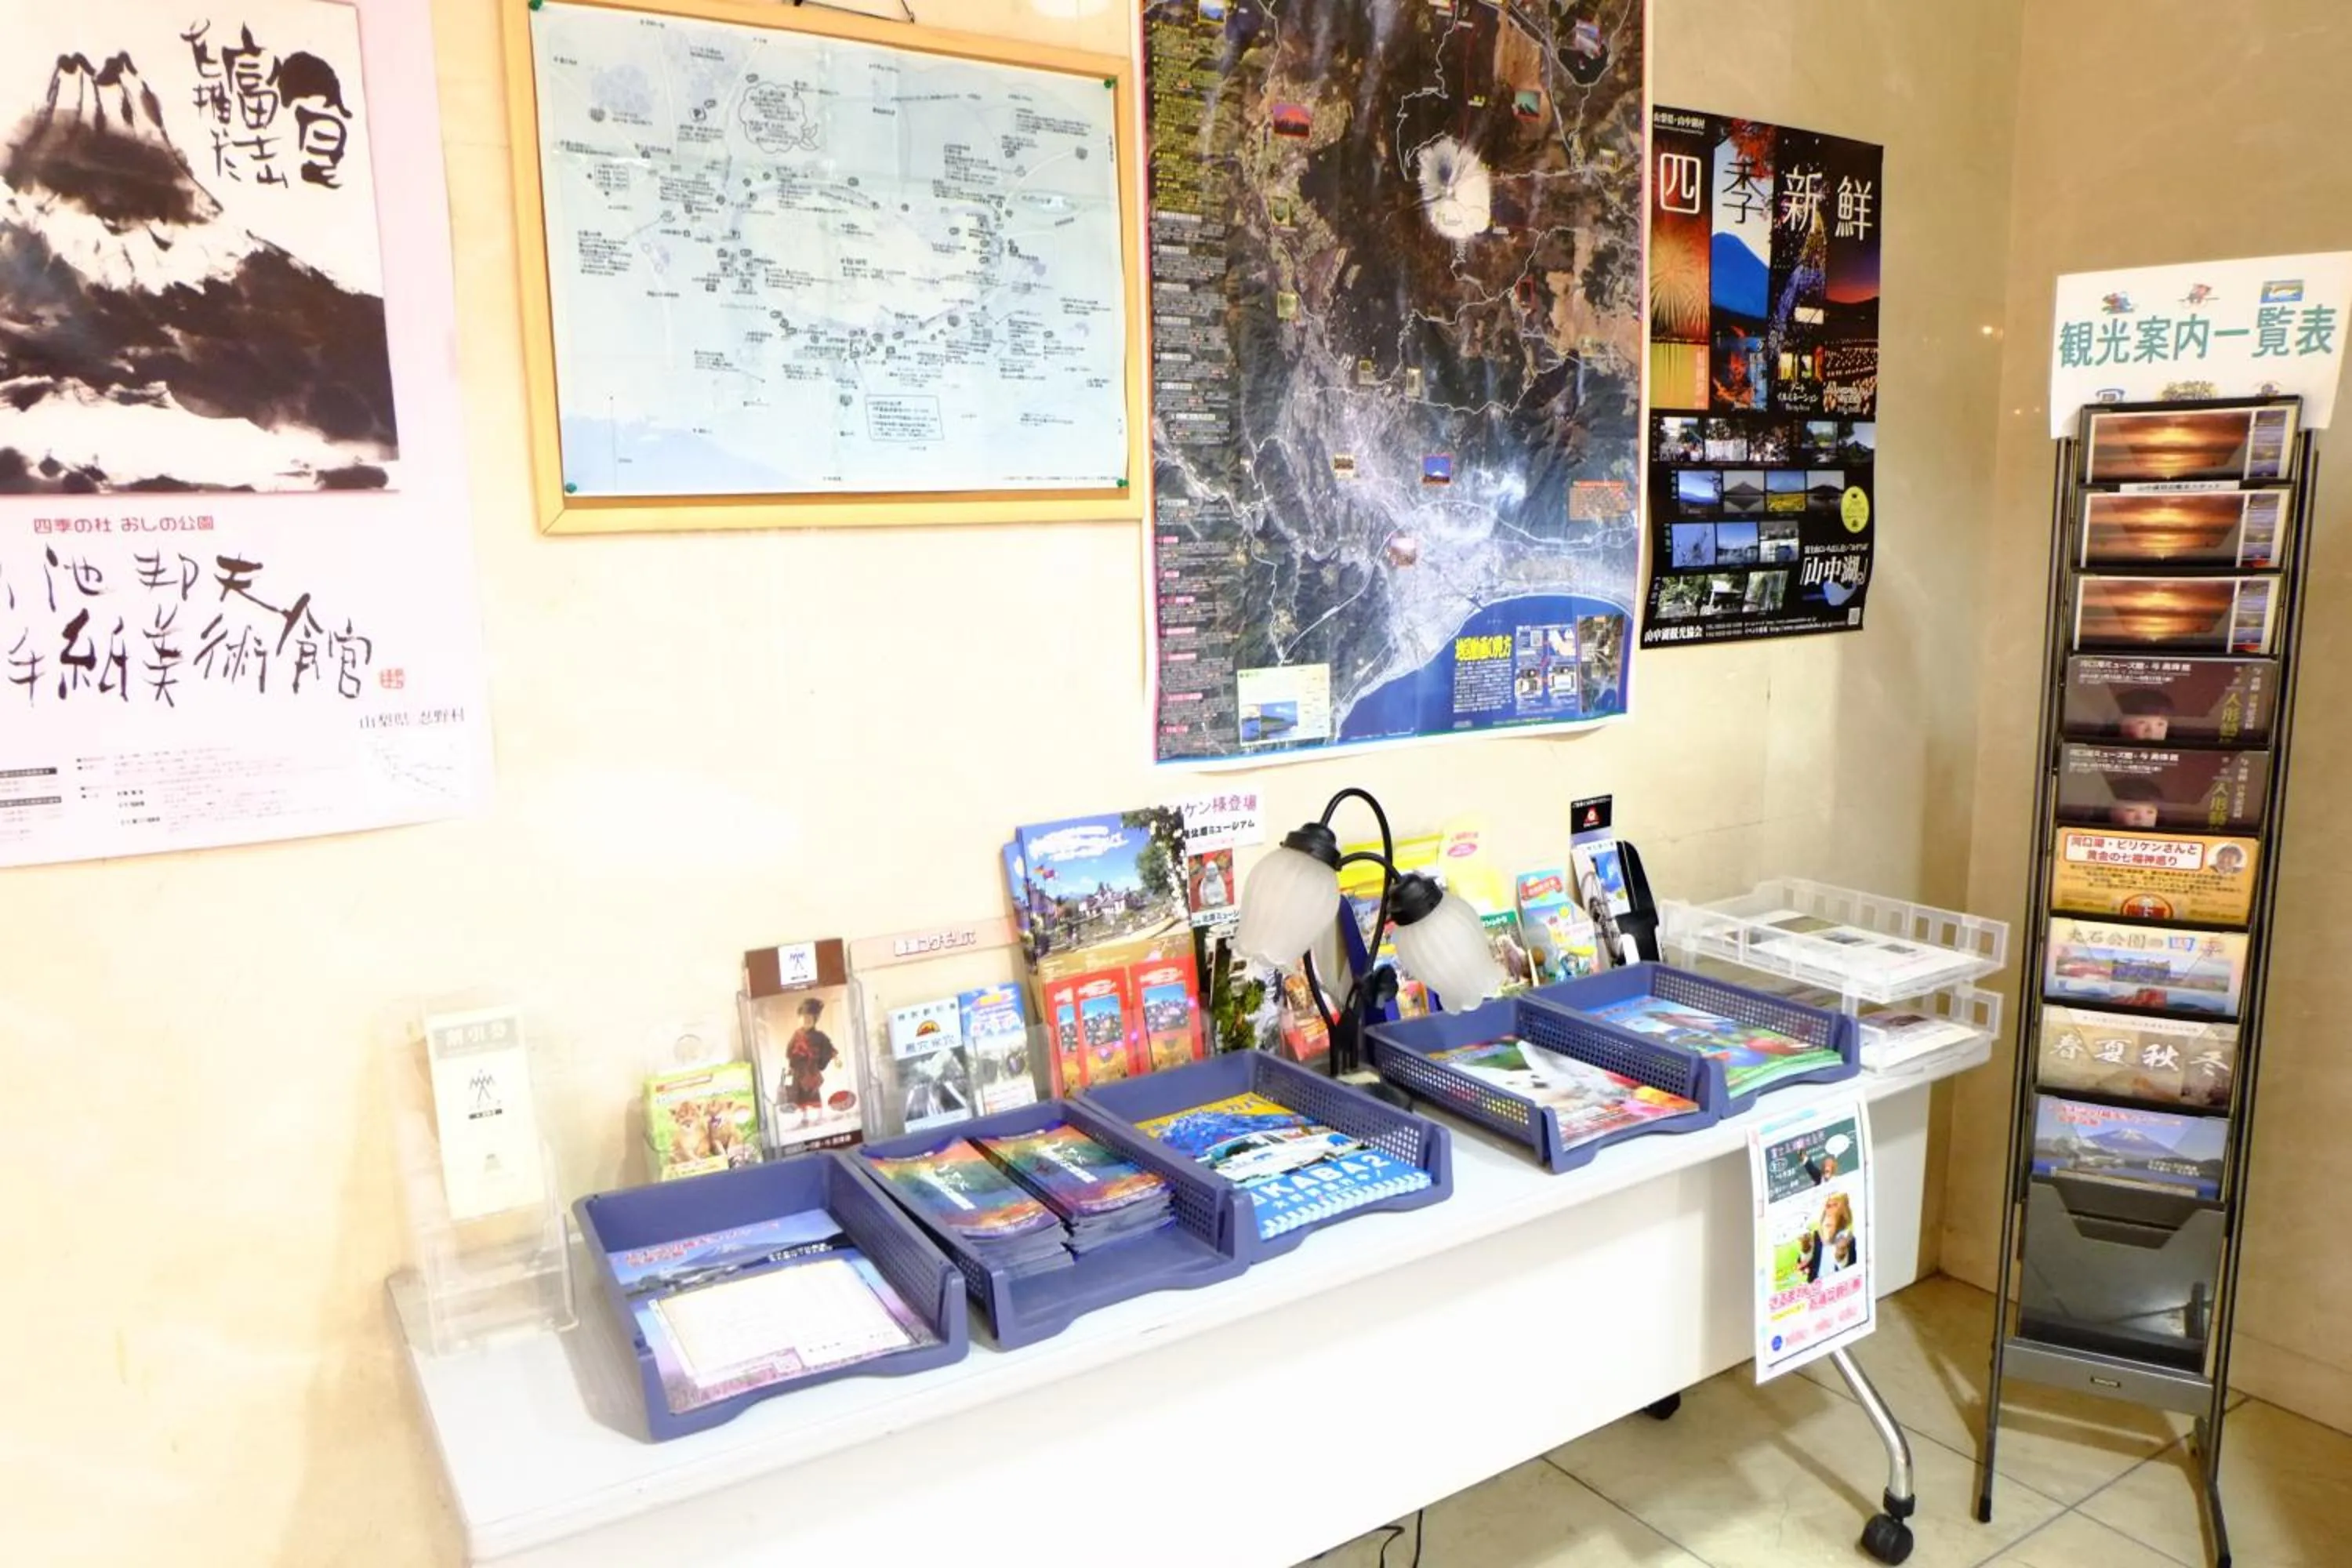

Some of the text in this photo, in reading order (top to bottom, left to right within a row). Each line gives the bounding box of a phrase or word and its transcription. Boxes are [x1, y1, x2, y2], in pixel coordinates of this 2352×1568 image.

[1660, 153, 1873, 241] 四季新鮮
[2059, 303, 2337, 368] 観光案内一覧表
[34, 515, 214, 534] 四季の杜 おしの公園
[2049, 1033, 2231, 1077] 春夏秋冬
